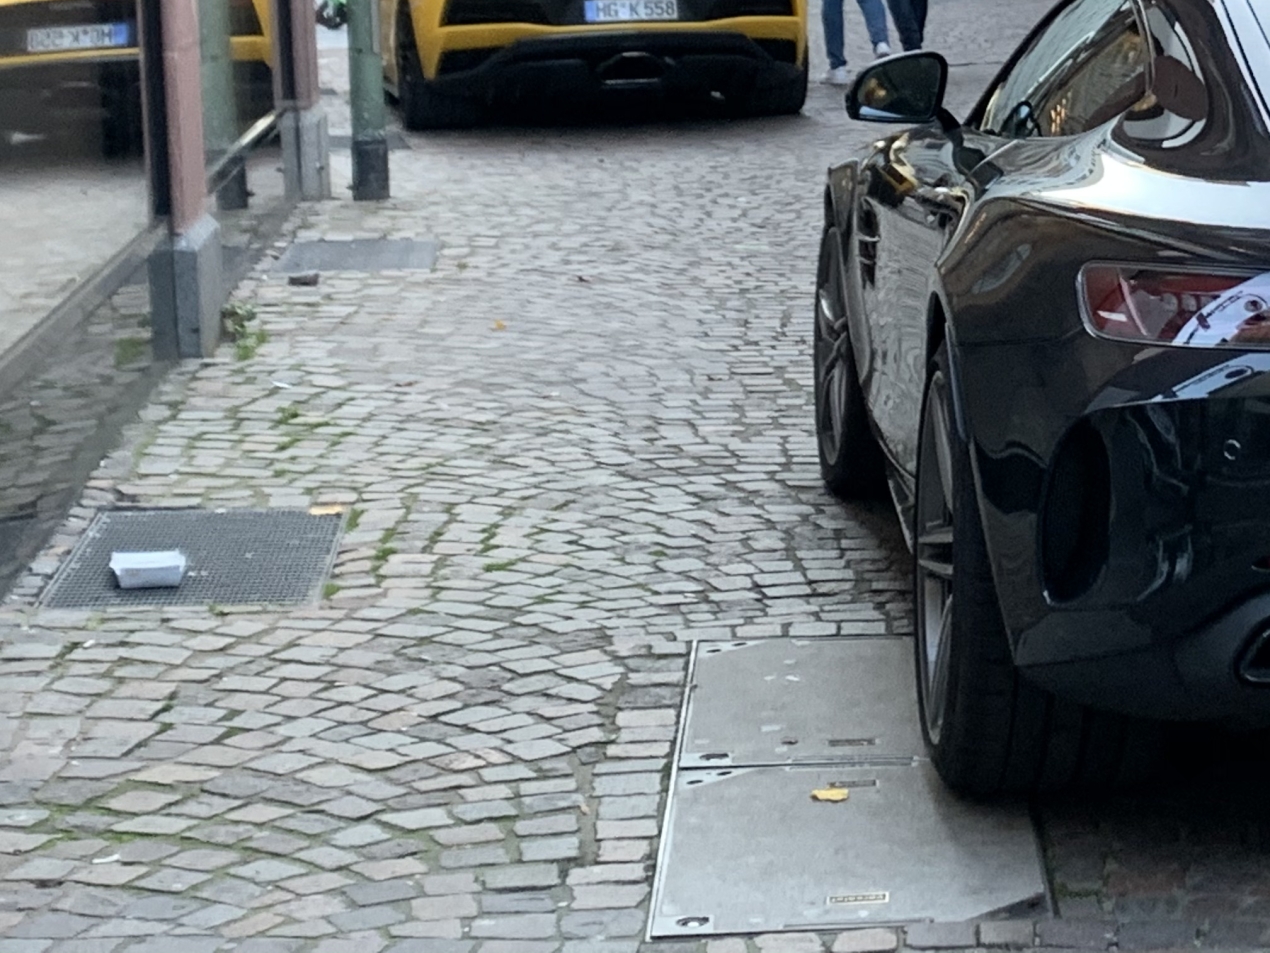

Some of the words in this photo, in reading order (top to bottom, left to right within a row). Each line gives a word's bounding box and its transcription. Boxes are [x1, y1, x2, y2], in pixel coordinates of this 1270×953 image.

[595, 1, 618, 18] HG
[629, 1, 641, 17] K
[643, 0, 675, 17] 558
